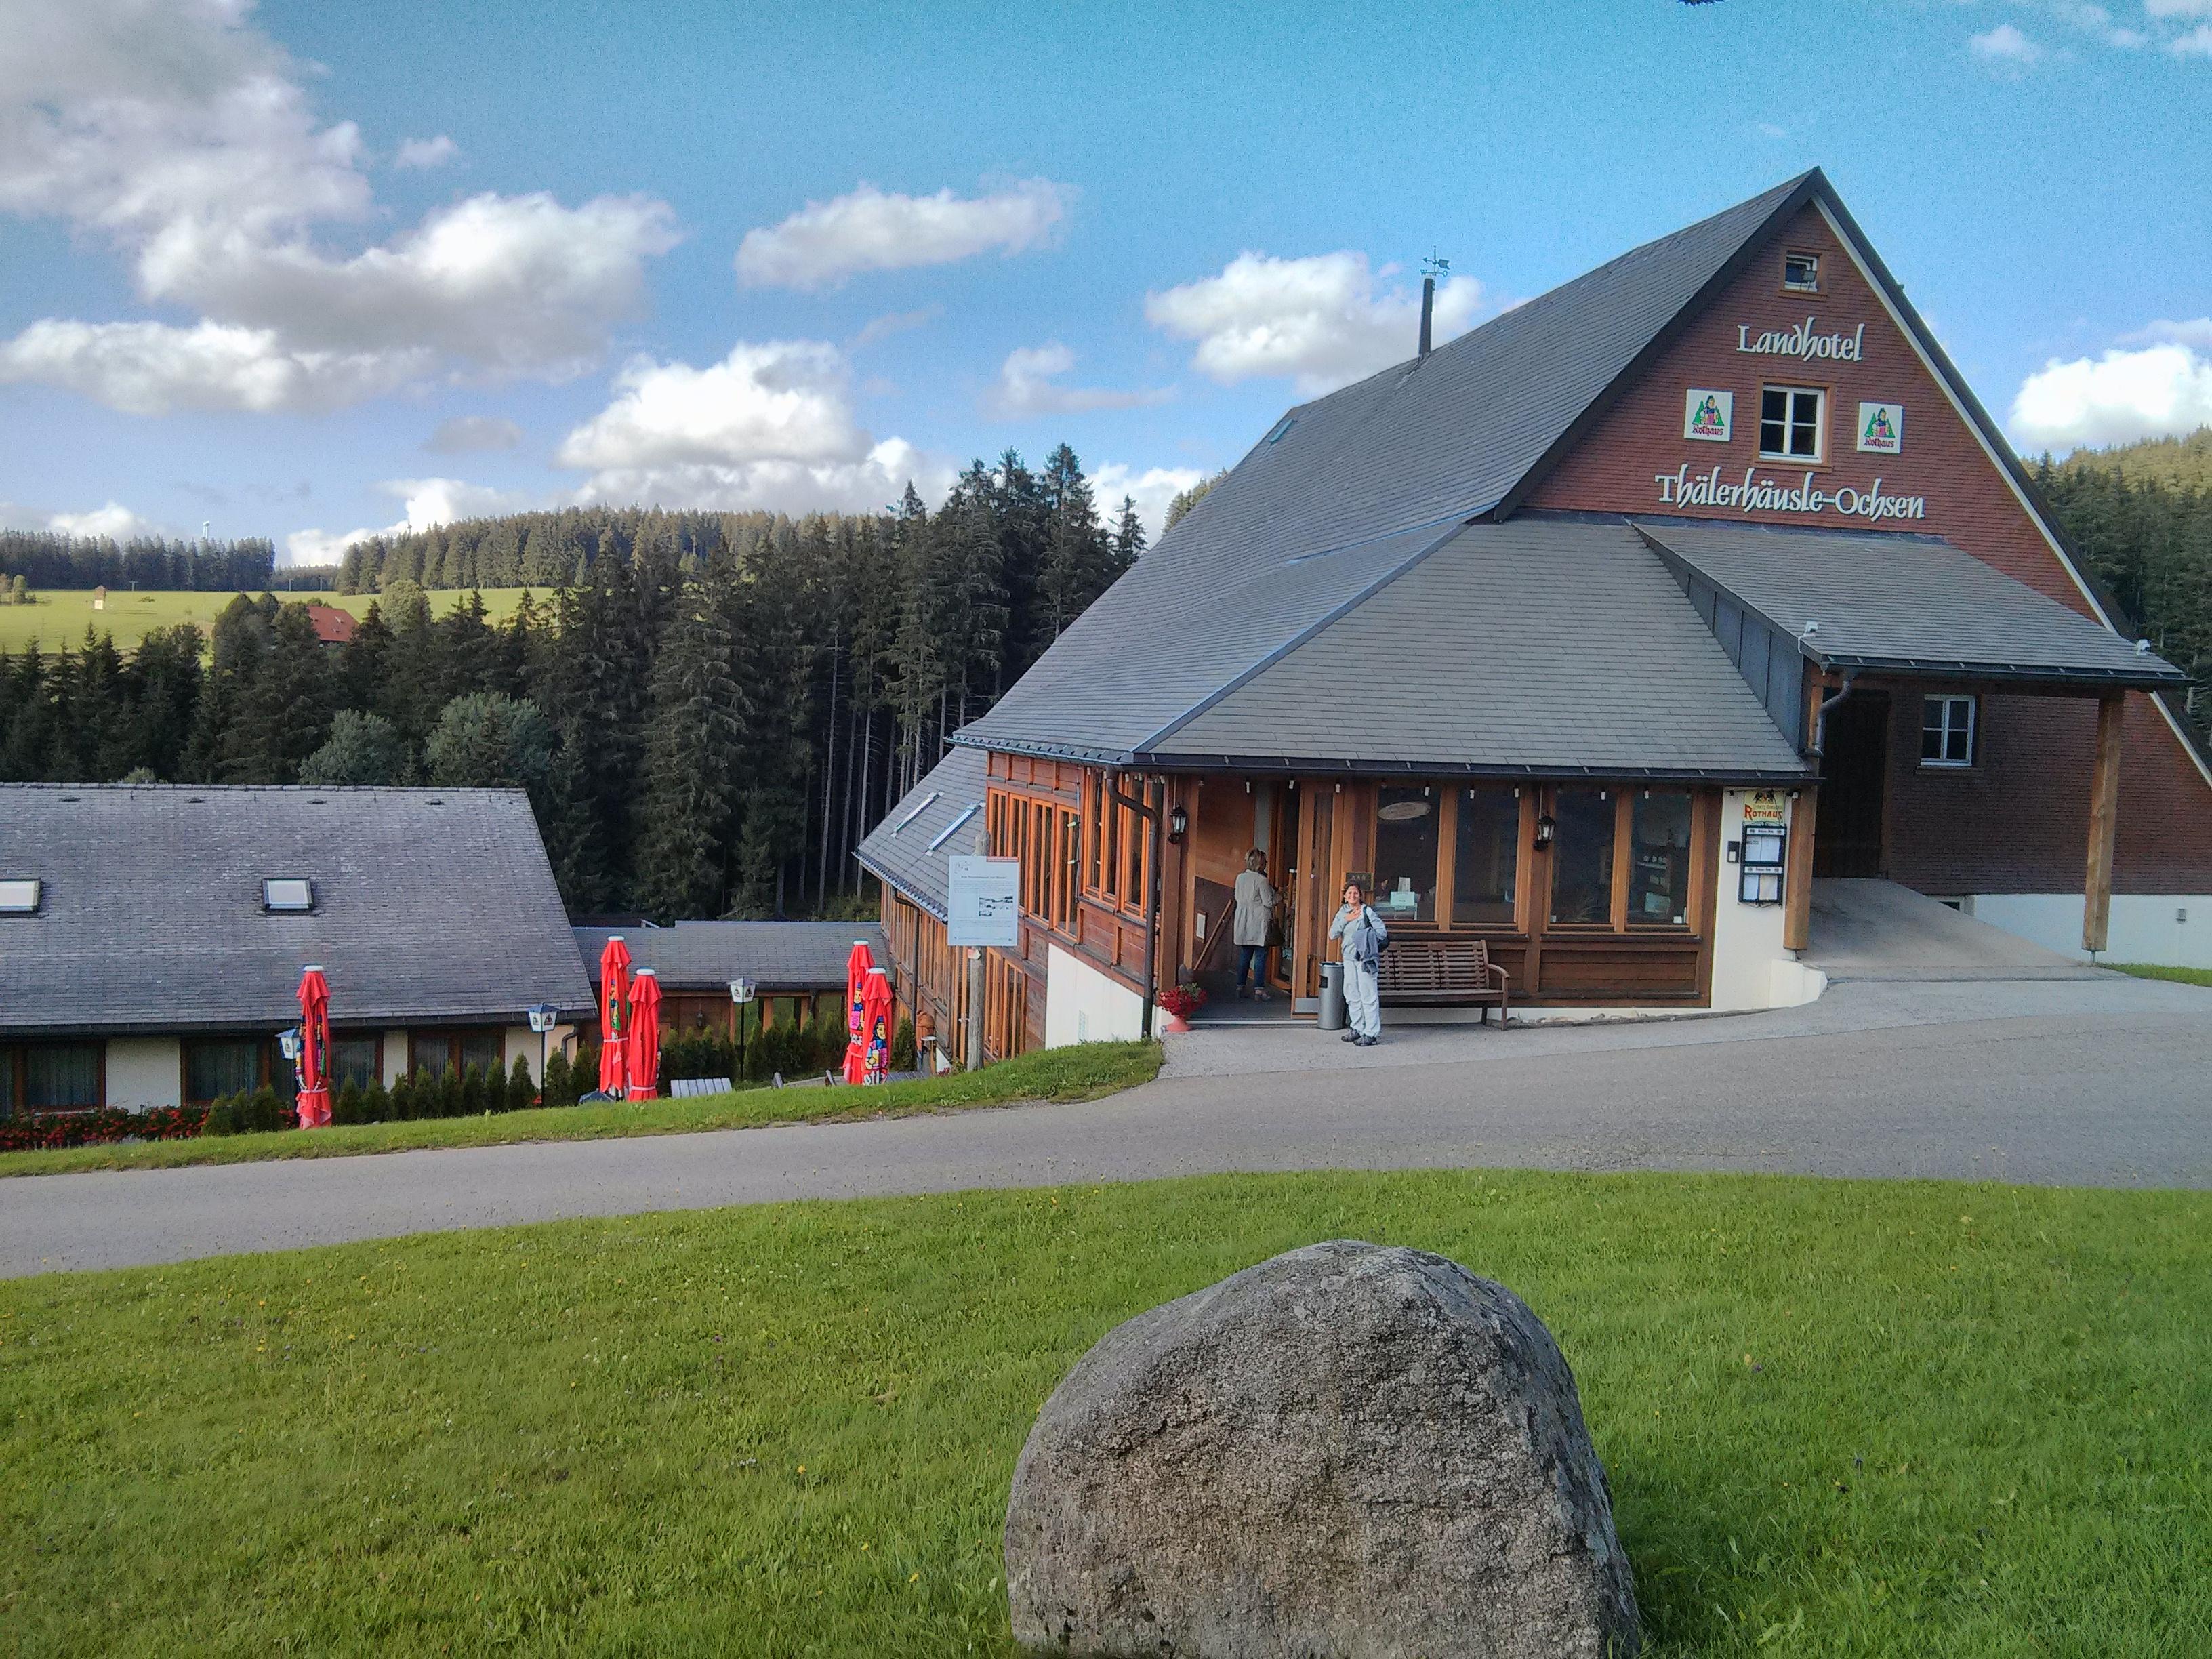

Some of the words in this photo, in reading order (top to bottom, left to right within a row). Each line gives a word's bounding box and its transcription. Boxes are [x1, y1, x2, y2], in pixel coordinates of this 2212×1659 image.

[1736, 316, 1865, 361] Landhotel
[1692, 424, 1723, 436] Rothaus
[1655, 464, 1925, 522] Thälerhäusle-Ochsen
[1744, 804, 1782, 821] ROTHAUS
